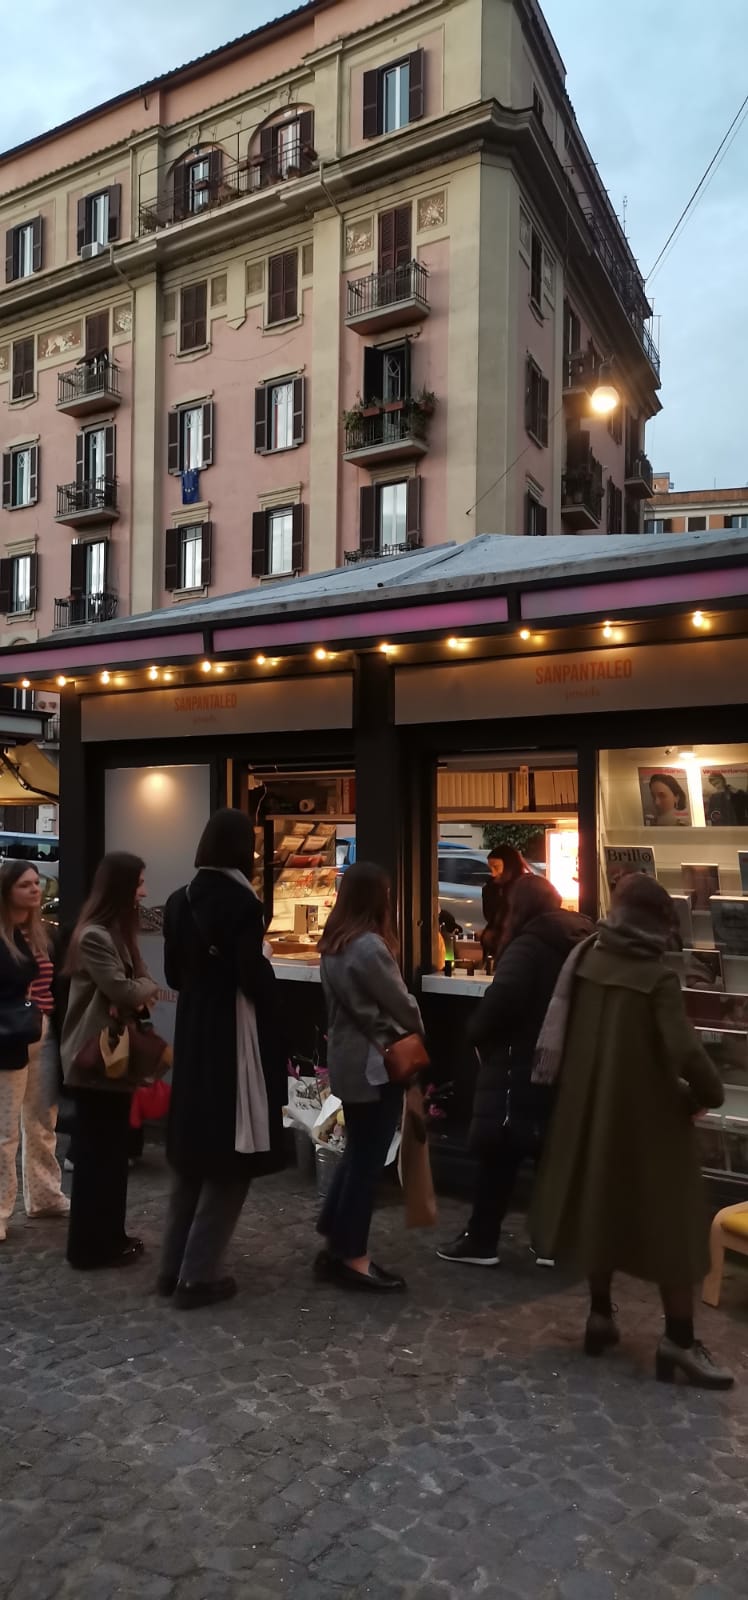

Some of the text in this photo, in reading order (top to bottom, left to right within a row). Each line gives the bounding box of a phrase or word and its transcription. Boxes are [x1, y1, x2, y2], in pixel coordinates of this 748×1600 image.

[535, 659, 632, 685] SANPANTALEO
[174, 693, 237, 711] SANPANTALEO
[608, 849, 652, 862] Brillo
